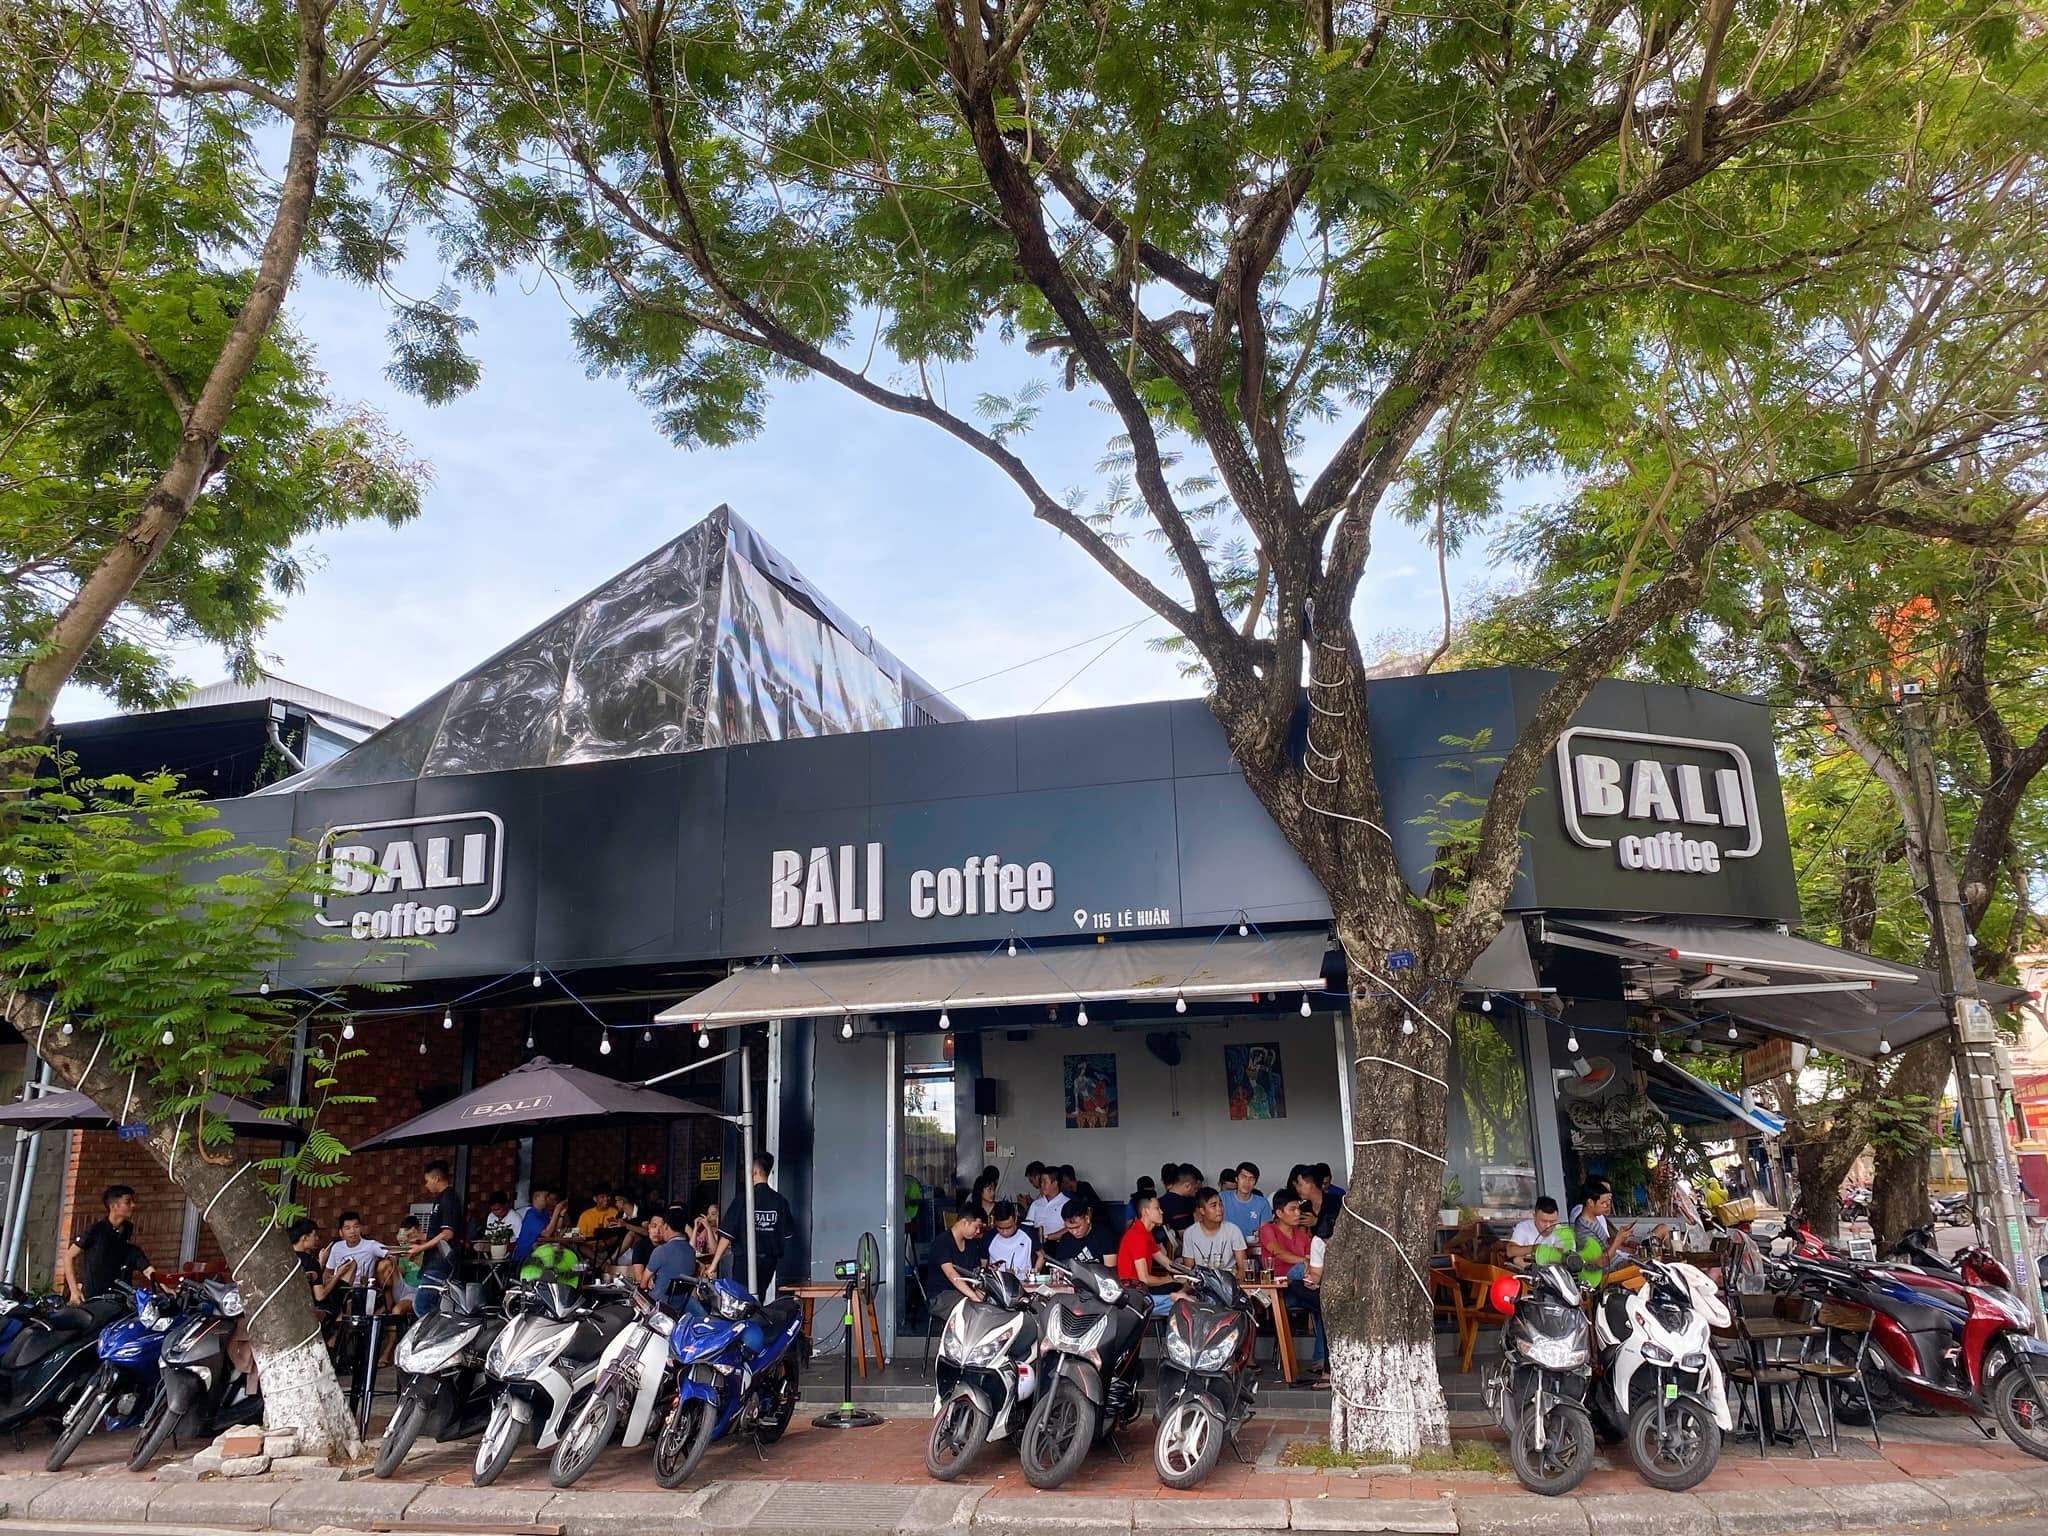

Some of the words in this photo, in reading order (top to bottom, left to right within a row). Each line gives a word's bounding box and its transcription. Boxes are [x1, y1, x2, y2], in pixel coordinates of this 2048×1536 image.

[1575, 754, 1746, 827] BALI
[331, 833, 487, 896] BALI
[1618, 831, 1721, 874] coffee
[771, 842, 883, 929] BALI
[910, 854, 1055, 919] coffee
[351, 901, 457, 940] coffee
[1092, 912, 1111, 929] 115
[1118, 908, 1133, 928] LÊ
[1137, 907, 1170, 927] HUÂN
[473, 1098, 542, 1115] BALI
